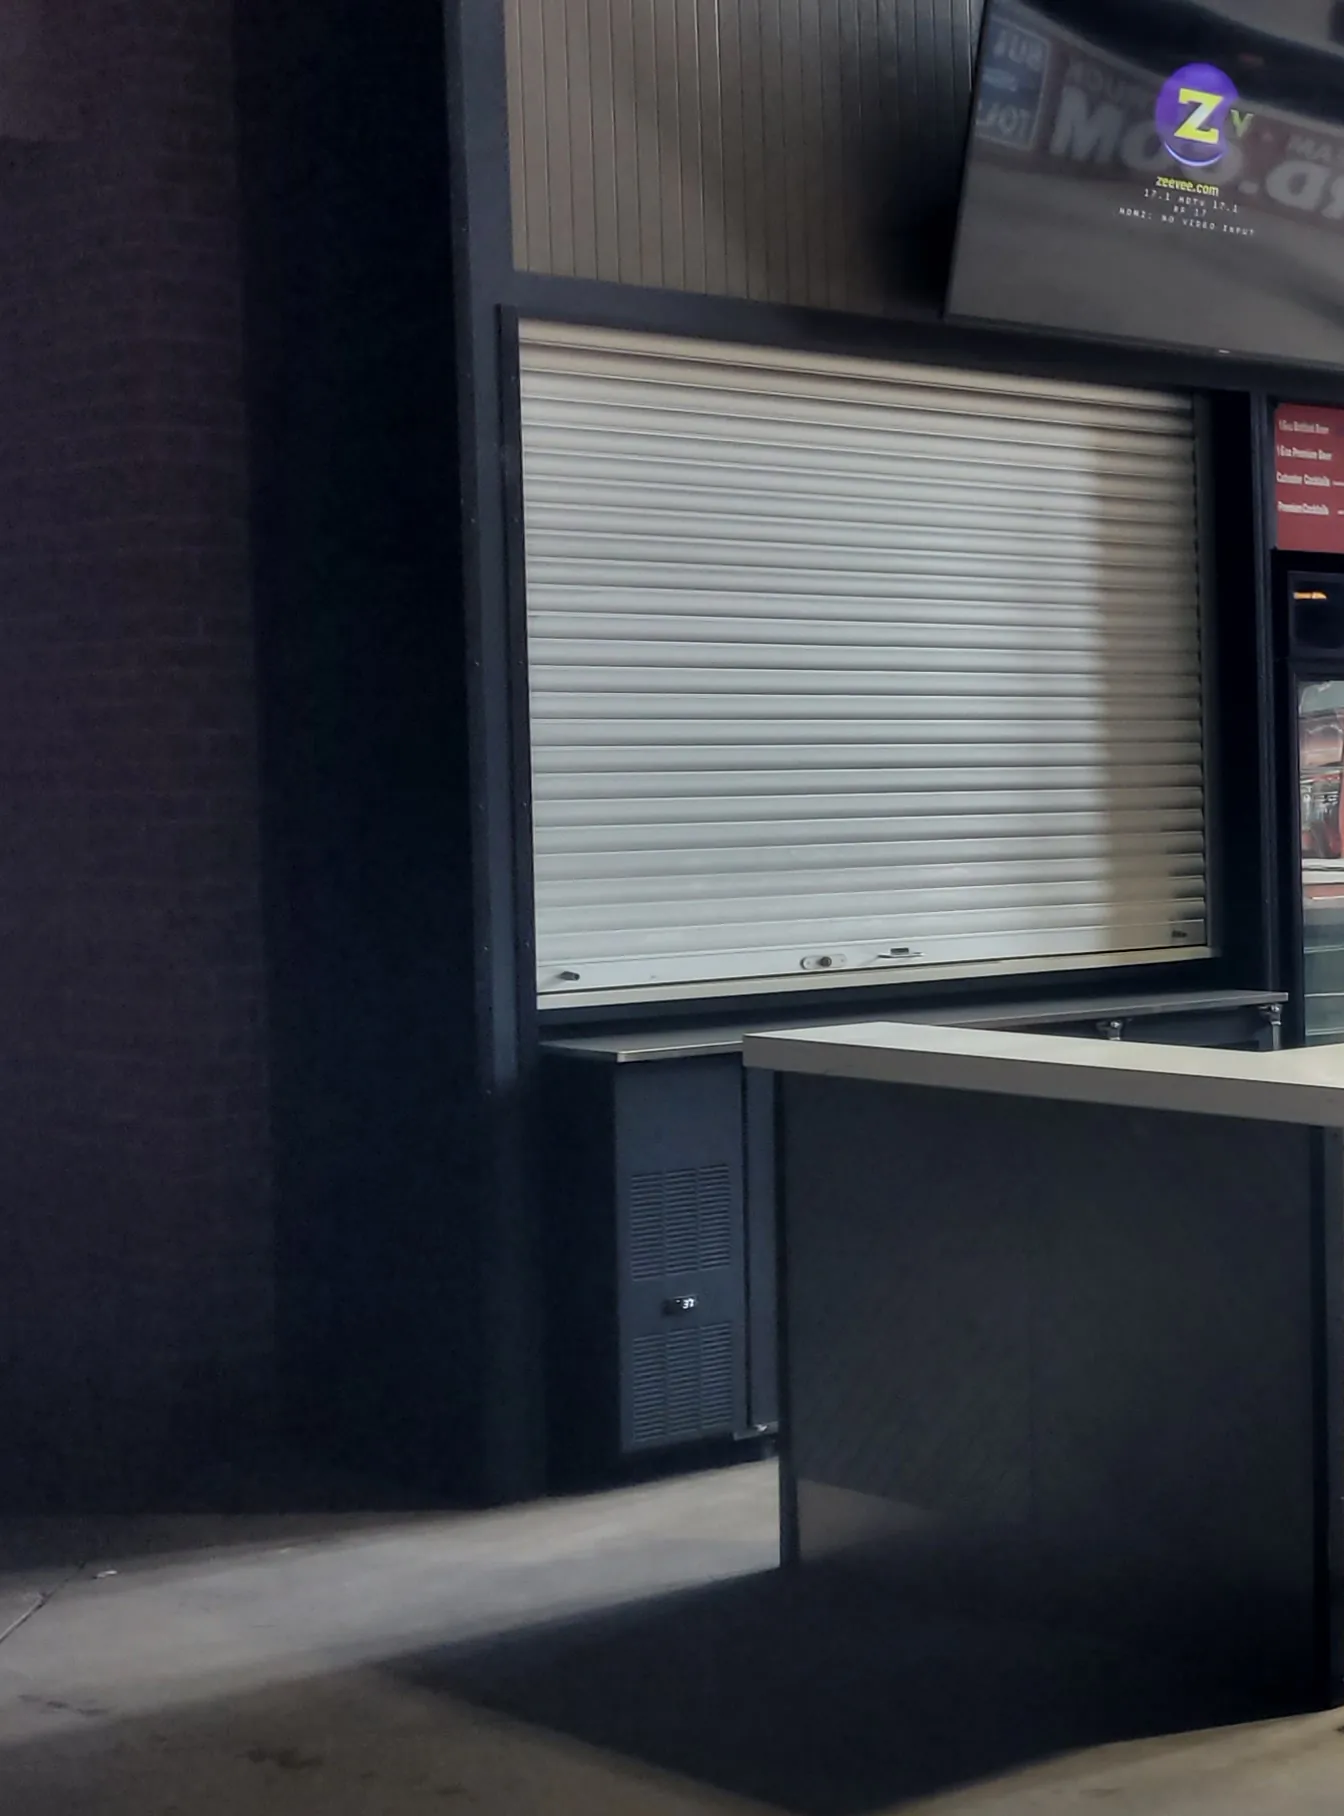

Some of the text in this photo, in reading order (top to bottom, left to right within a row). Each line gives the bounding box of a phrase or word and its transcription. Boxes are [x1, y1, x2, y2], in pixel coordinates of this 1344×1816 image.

[1156, 176, 1219, 197] zeevee.com
[1162, 214, 1175, 224] NO
[1182, 218, 1215, 231] VIDEO
[1223, 224, 1255, 236] INPUT
